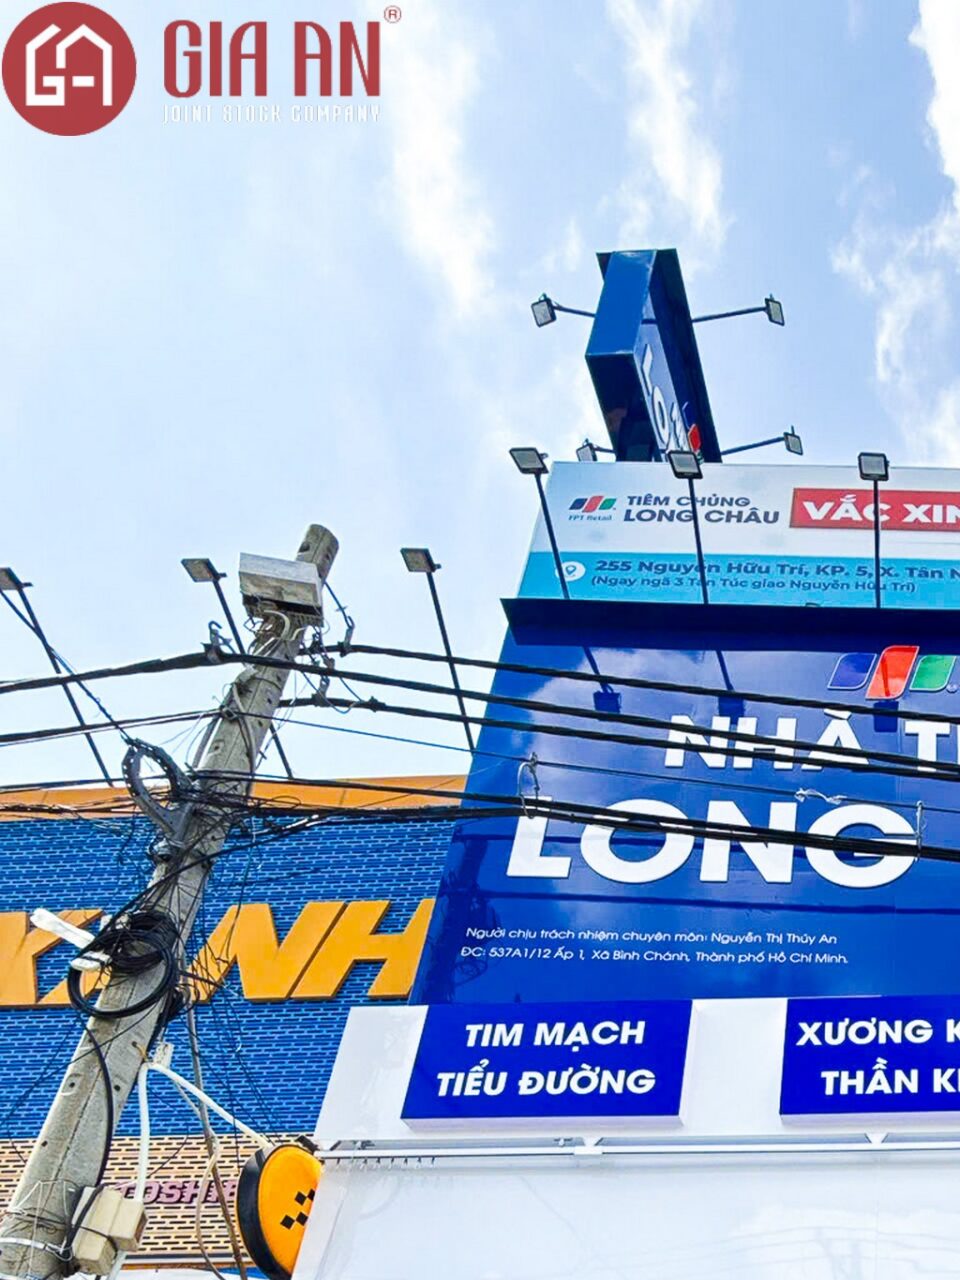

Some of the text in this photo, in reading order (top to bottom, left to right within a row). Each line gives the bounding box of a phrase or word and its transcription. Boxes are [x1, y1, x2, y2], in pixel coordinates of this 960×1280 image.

[627, 493, 751, 507] TIÊM CHỦNG
[802, 494, 890, 522] VẮC
[624, 507, 779, 524] LONG CHÂU
[591, 575, 636, 587] (Ngay
[674, 578, 684, 587] 3
[720, 578, 748, 588] Túc
[752, 579, 786, 590] giao
[595, 560, 632, 571] 255
[726, 562, 771, 576] Hữu
[816, 565, 850, 576] KP.
[905, 565, 943, 579] Tân
[665, 709, 869, 771] NHÀ
[507, 797, 918, 888] LONG
[466, 927, 506, 940] Người
[508, 929, 536, 941] chịu
[540, 929, 574, 939] trách
[578, 929, 619, 941] nhiệm
[622, 931, 671, 943] chuyên
[711, 931, 761, 945] Nguyễn
[766, 932, 783, 944] Thị
[818, 934, 837, 944] An
[460, 946, 486, 957] ĐC:
[488, 947, 551, 959] 537A1/12
[553, 946, 574, 960] Ấp
[592, 949, 609, 960] Xã
[612, 949, 640, 960] Bình
[696, 951, 735, 962] Thành
[738, 951, 765, 964] phố
[768, 952, 786, 963] Hồ
[790, 952, 812, 963] Chí
[463, 1021, 645, 1052] TIM MẠCH
[795, 1019, 933, 1046] XƯƠNG
[436, 1058, 656, 1097] TIỂU ĐƯỜNG
[820, 1056, 920, 1096] THẦN
